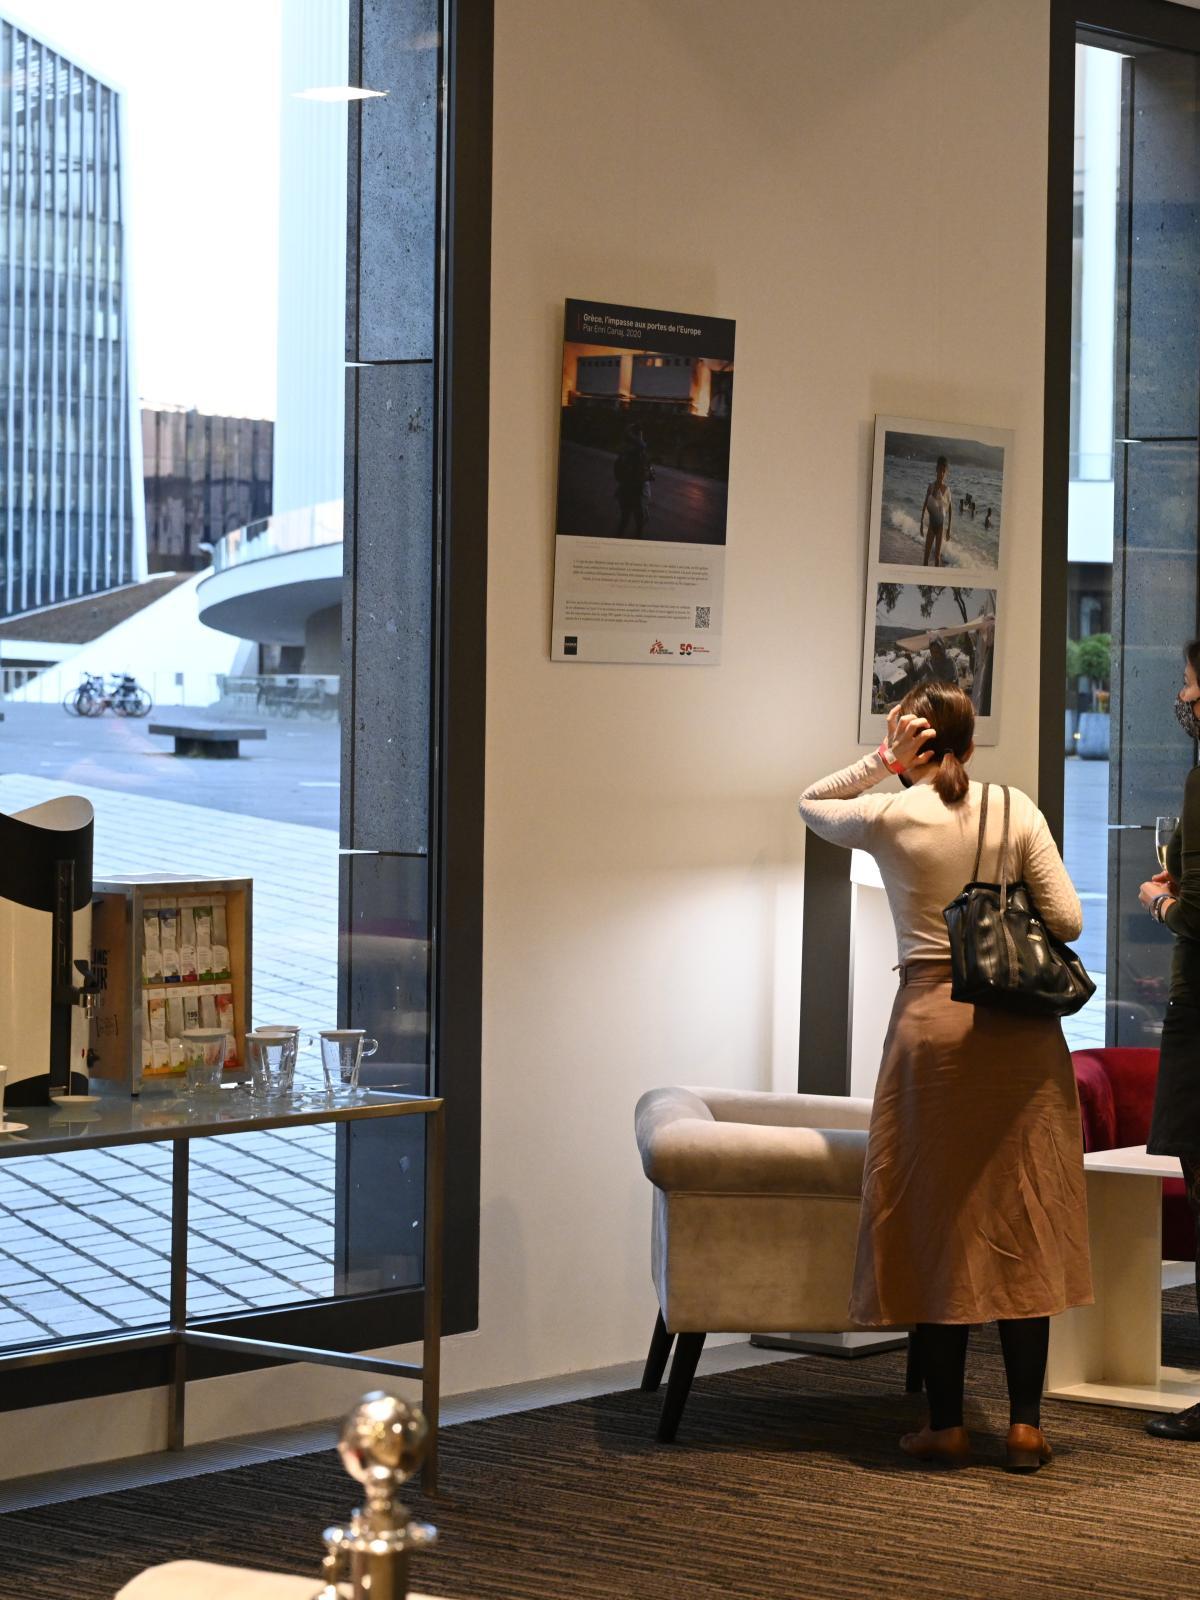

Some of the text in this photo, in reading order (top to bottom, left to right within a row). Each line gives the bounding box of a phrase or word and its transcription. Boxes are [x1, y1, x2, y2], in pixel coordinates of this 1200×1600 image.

[583, 313, 604, 324] Grèce,
[604, 316, 634, 328] l'impasse
[647, 322, 667, 332] portes
[668, 324, 676, 333] de
[677, 325, 702, 337] l'Europe
[583, 323, 592, 332] Par
[626, 329, 641, 338] 2020
